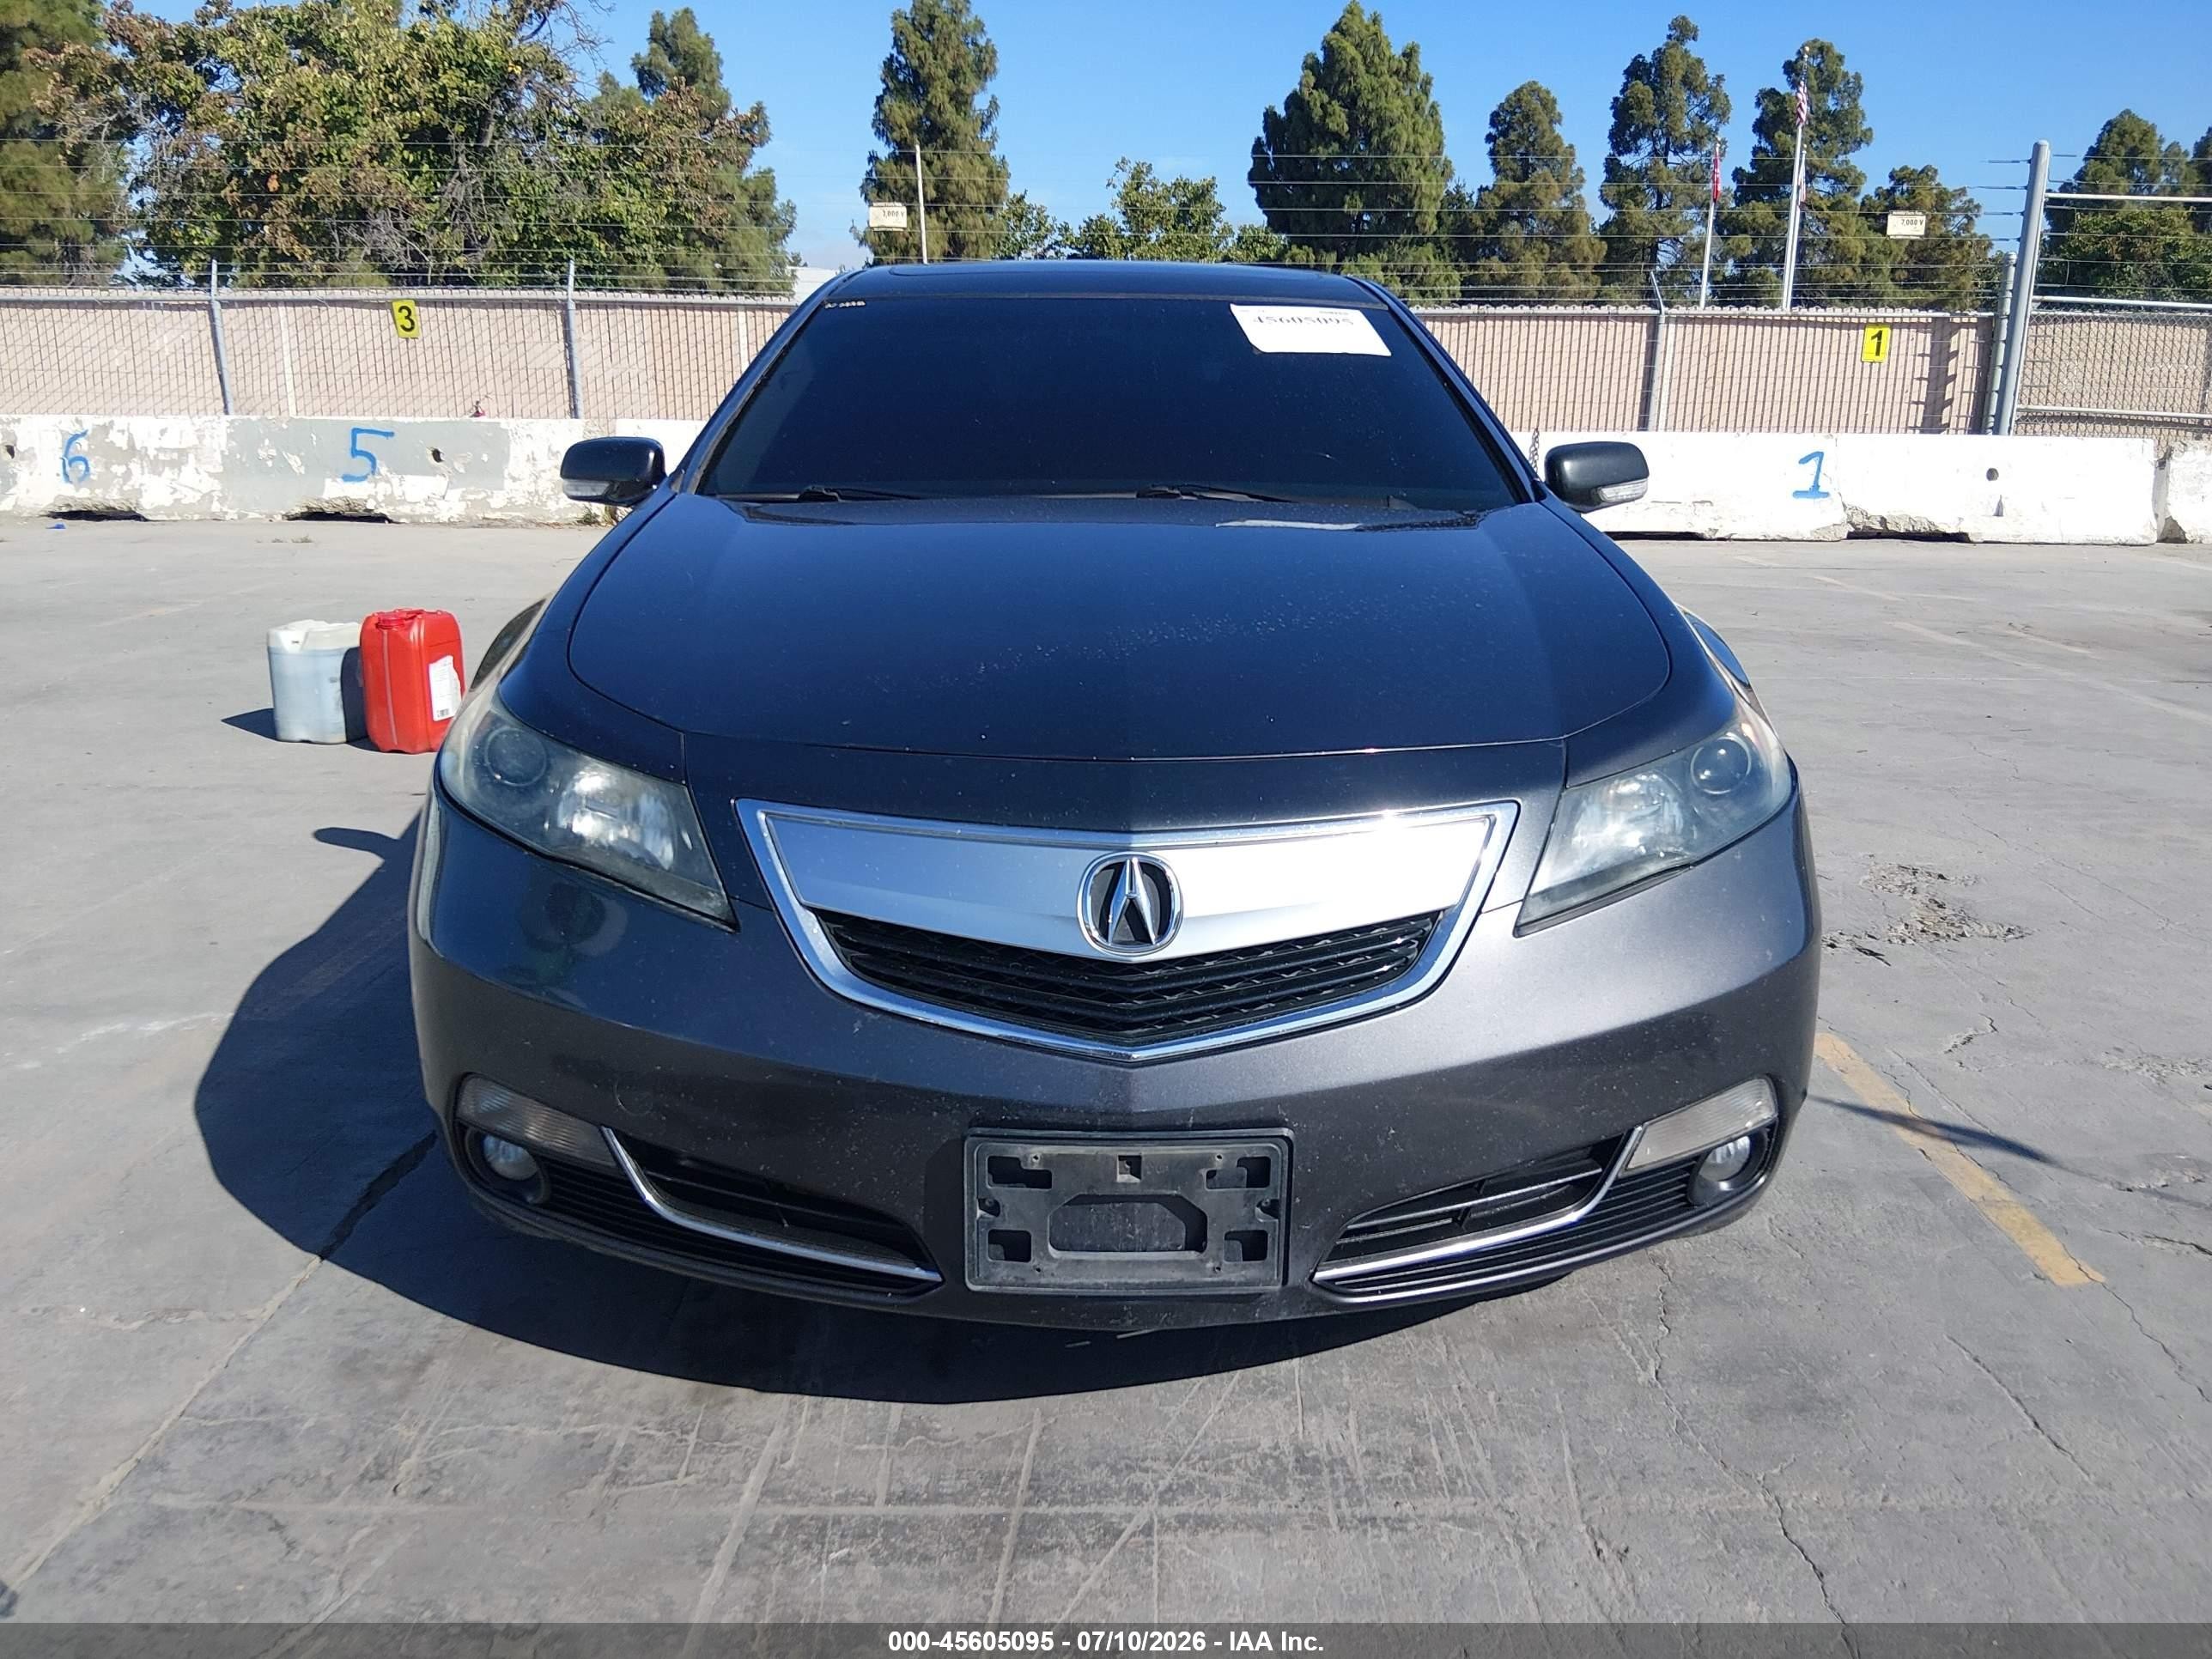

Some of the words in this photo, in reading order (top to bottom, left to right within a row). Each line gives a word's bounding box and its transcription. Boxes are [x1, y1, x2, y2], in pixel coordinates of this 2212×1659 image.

[398, 305, 416, 332] 3
[1870, 329, 1884, 357] 1
[62, 428, 90, 483] 6
[342, 427, 395, 483] 5
[1792, 451, 1831, 499] 1
